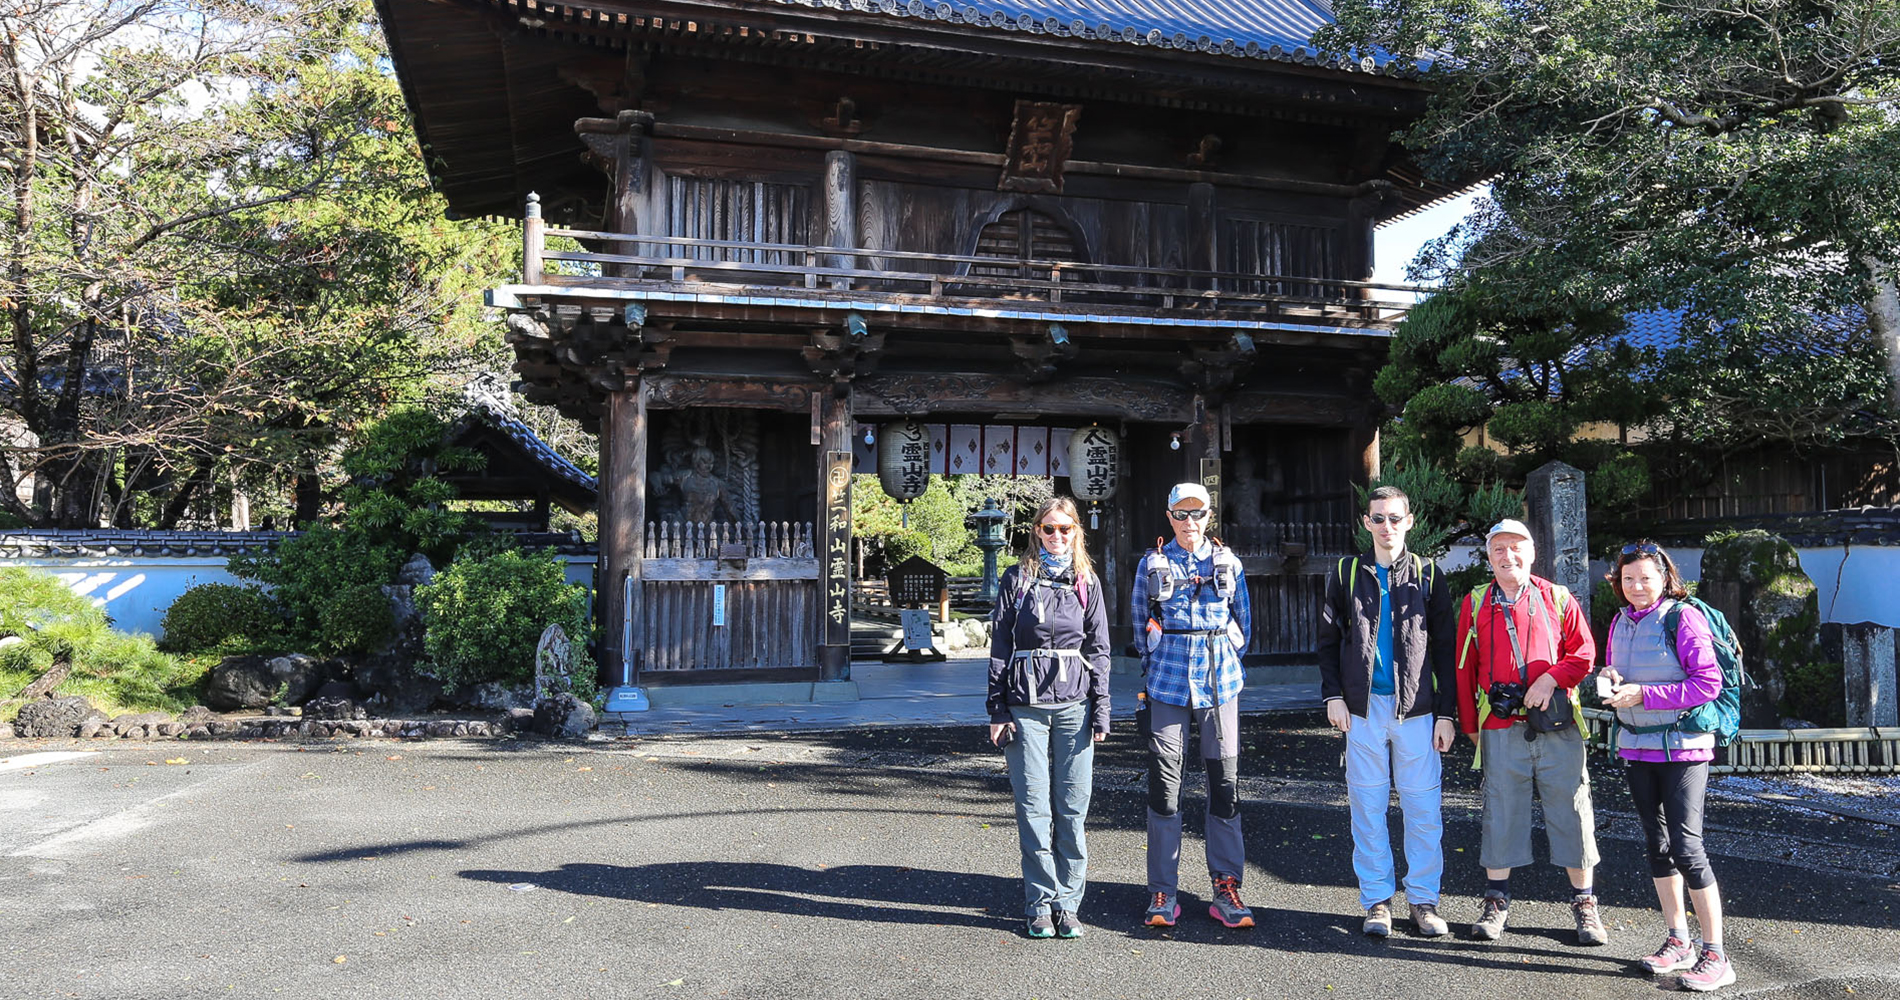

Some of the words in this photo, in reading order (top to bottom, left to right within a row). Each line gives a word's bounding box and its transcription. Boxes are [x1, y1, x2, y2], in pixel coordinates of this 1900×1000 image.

[828, 489, 848, 624] 竺和山霊山寺
